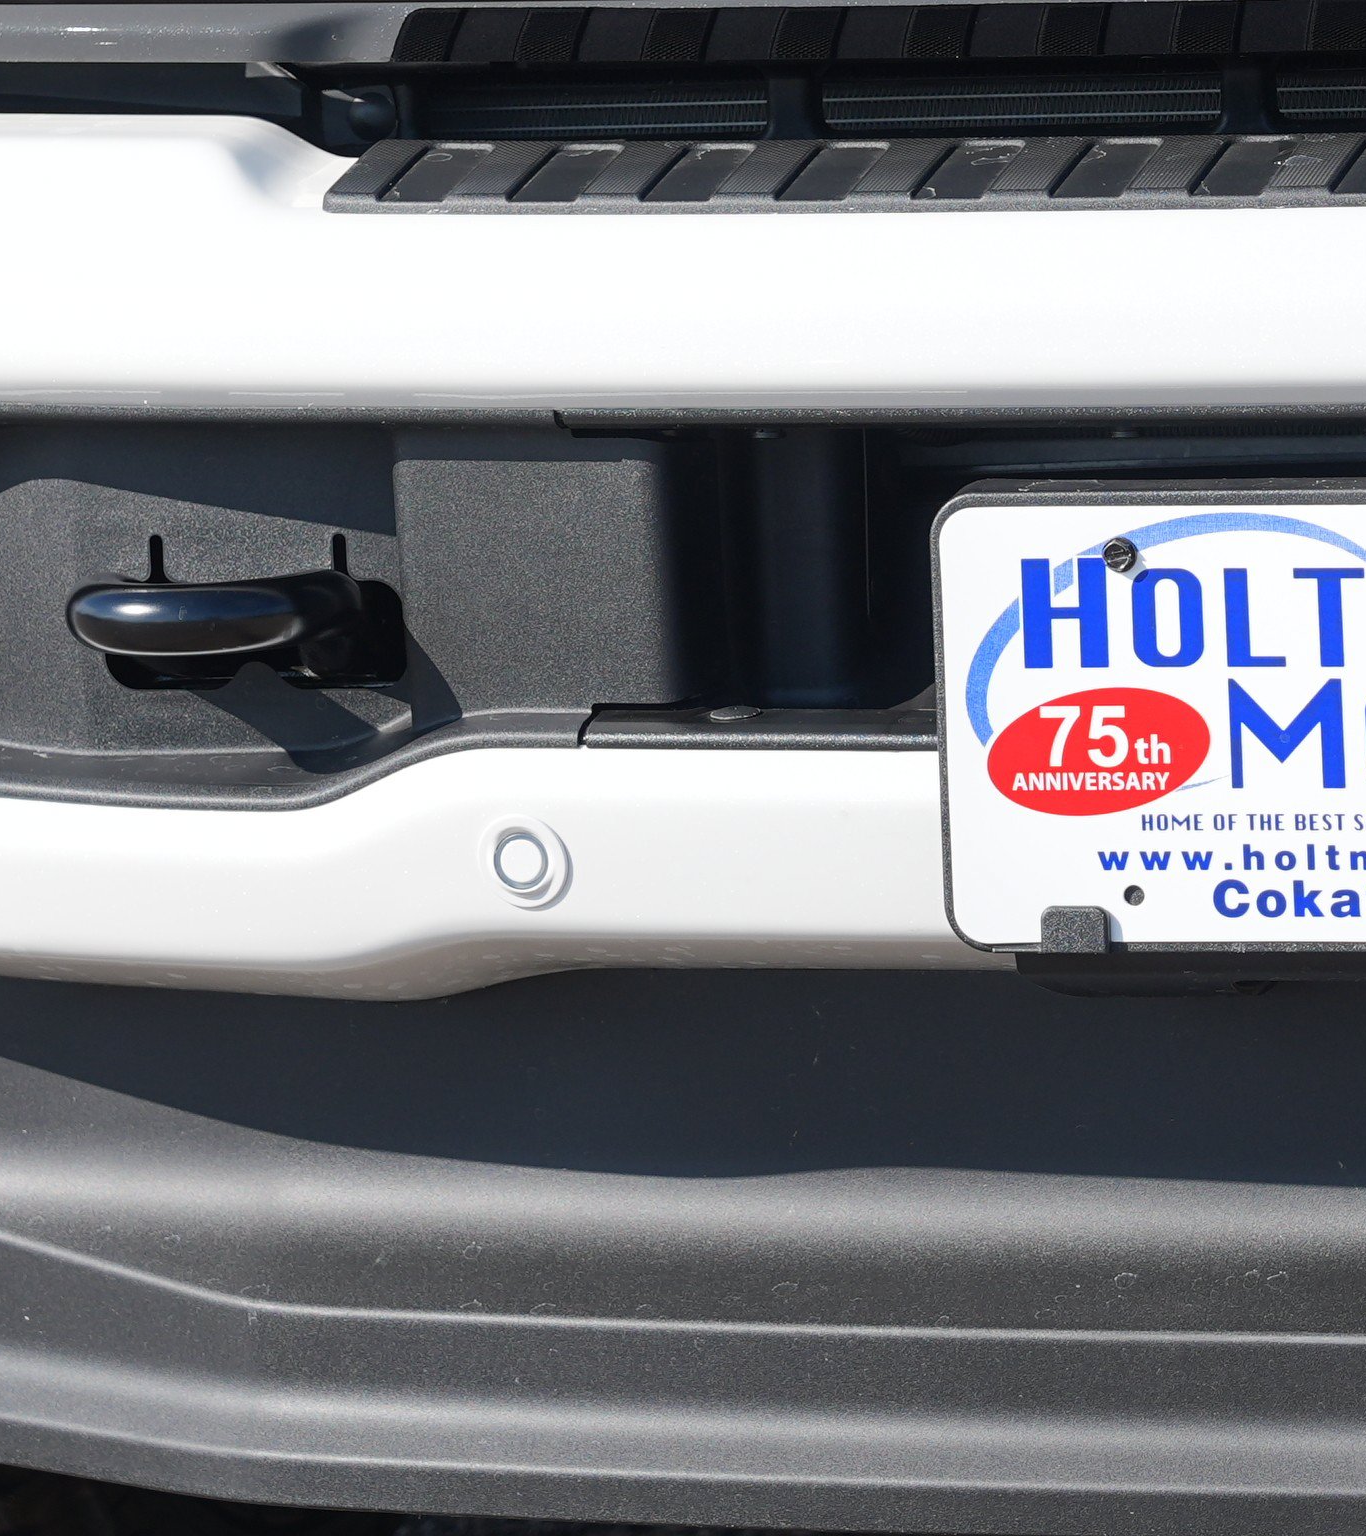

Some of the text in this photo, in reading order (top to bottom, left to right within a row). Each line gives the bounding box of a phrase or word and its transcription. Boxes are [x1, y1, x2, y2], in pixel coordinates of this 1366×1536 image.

[1021, 557, 1365, 669] HOLT
[1039, 704, 1172, 769] 75th
[1012, 771, 1170, 792] ANNIVERSARY
[1141, 813, 1204, 831] HOME
[1213, 813, 1238, 831] OF
[1246, 813, 1285, 831] THE
[1294, 813, 1346, 831] BEST
